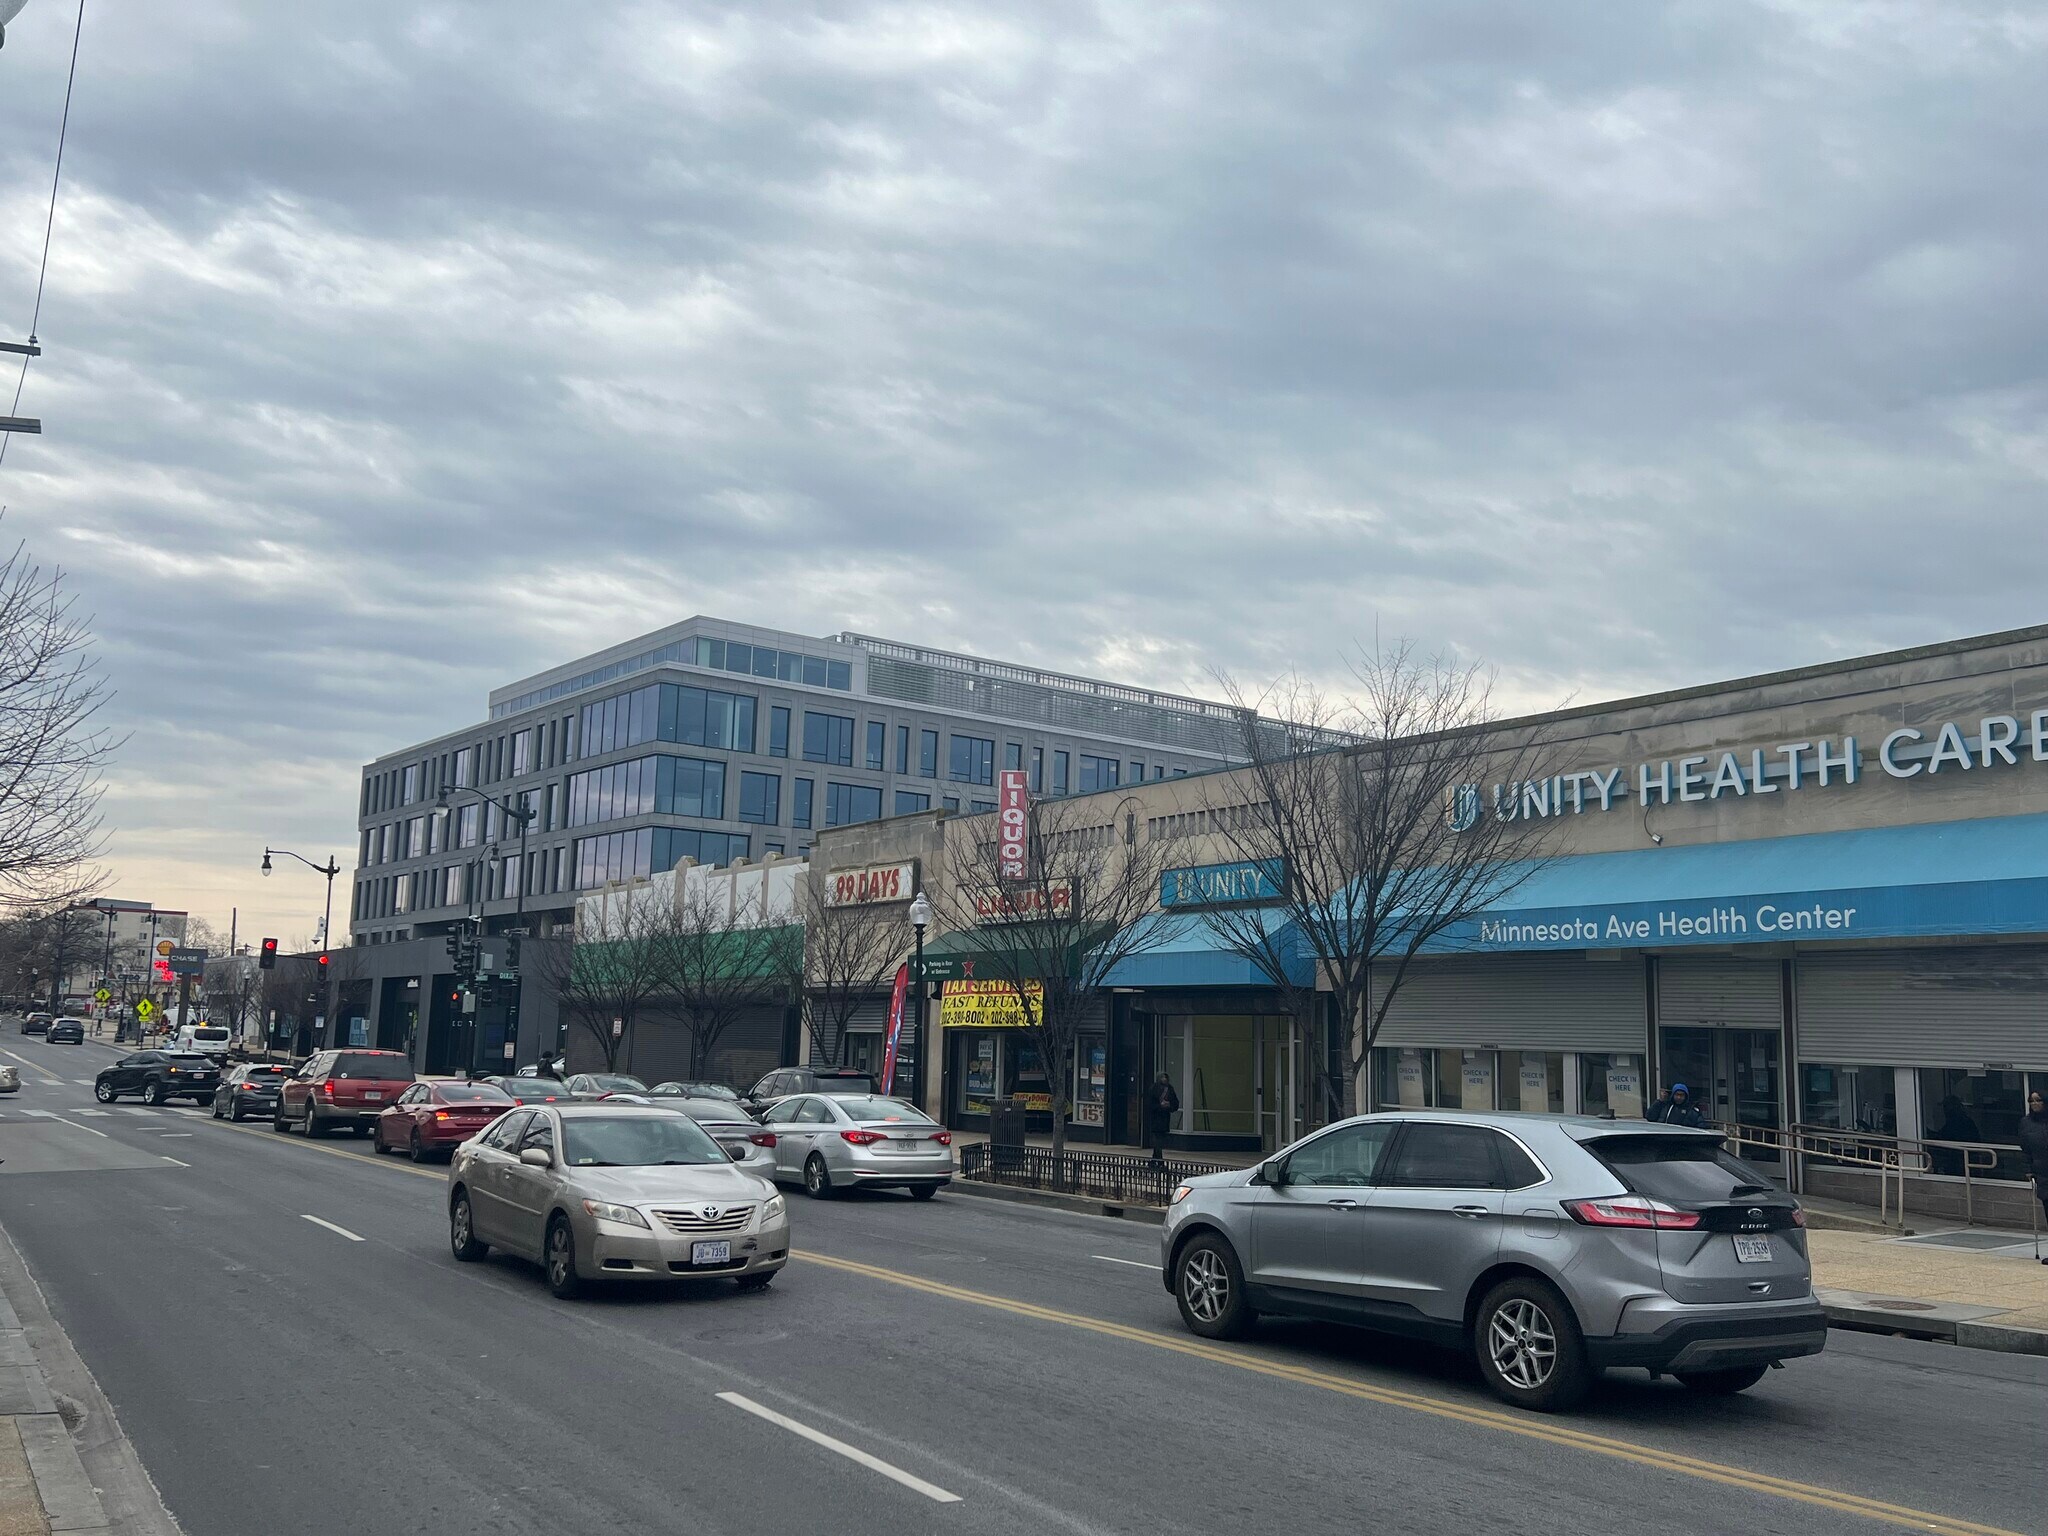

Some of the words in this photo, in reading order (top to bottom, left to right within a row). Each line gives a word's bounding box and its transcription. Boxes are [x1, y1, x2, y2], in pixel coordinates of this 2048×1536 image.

[1493, 767, 1621, 823] UNITY
[1639, 736, 1858, 806] HEALTH
[1879, 709, 2048, 778] CARE
[1002, 773, 1024, 877] LIQUOR
[836, 874, 855, 902] 99
[857, 868, 900, 901] DAYS
[1201, 868, 1263, 897] UNITY
[1480, 917, 1598, 942] Minnesota
[1605, 914, 1650, 939] Ave
[1658, 906, 1747, 936] Health
[1755, 903, 1857, 932] Center
[943, 996, 974, 1009] FAST
[976, 994, 1040, 1009] REFUNS
[944, 979, 967, 994] TAX
[971, 978, 1041, 993] SERVIES
[1608, 1075, 1629, 1083] CHECK
